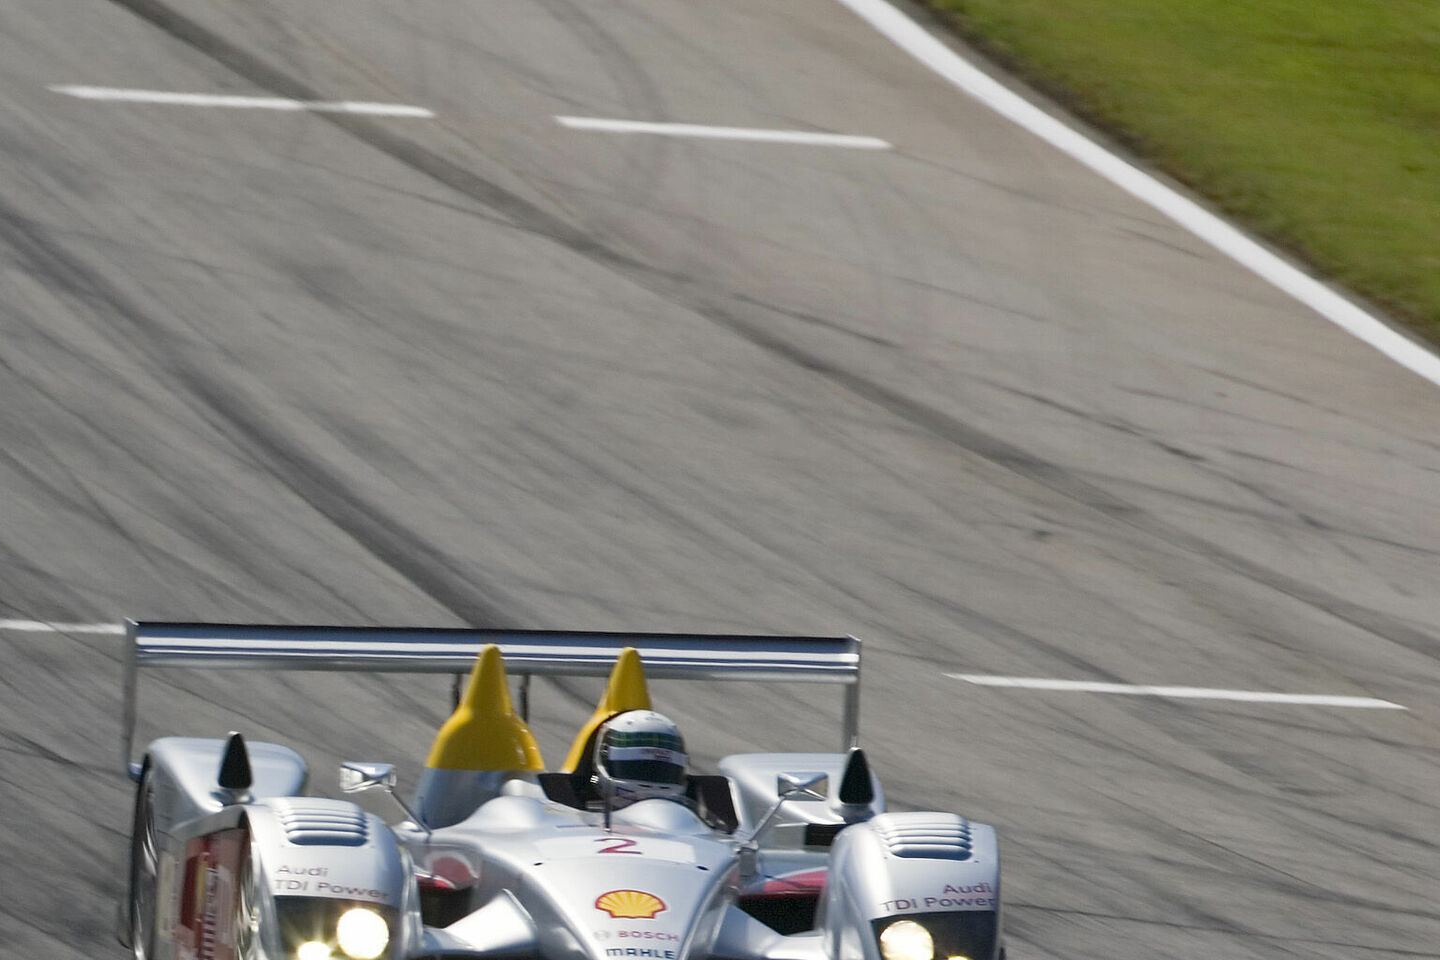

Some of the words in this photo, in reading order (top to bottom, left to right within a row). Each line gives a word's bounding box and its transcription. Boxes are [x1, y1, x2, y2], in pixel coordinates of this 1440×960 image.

[594, 837, 644, 855] 2
[277, 865, 329, 877] Audi
[275, 879, 309, 892] TDI
[317, 881, 389, 899] Power
[943, 882, 993, 894] Audi
[880, 898, 918, 912] TDI
[924, 896, 999, 908] Power
[618, 930, 679, 941] BOSCH
[606, 947, 677, 960] MAHLE
